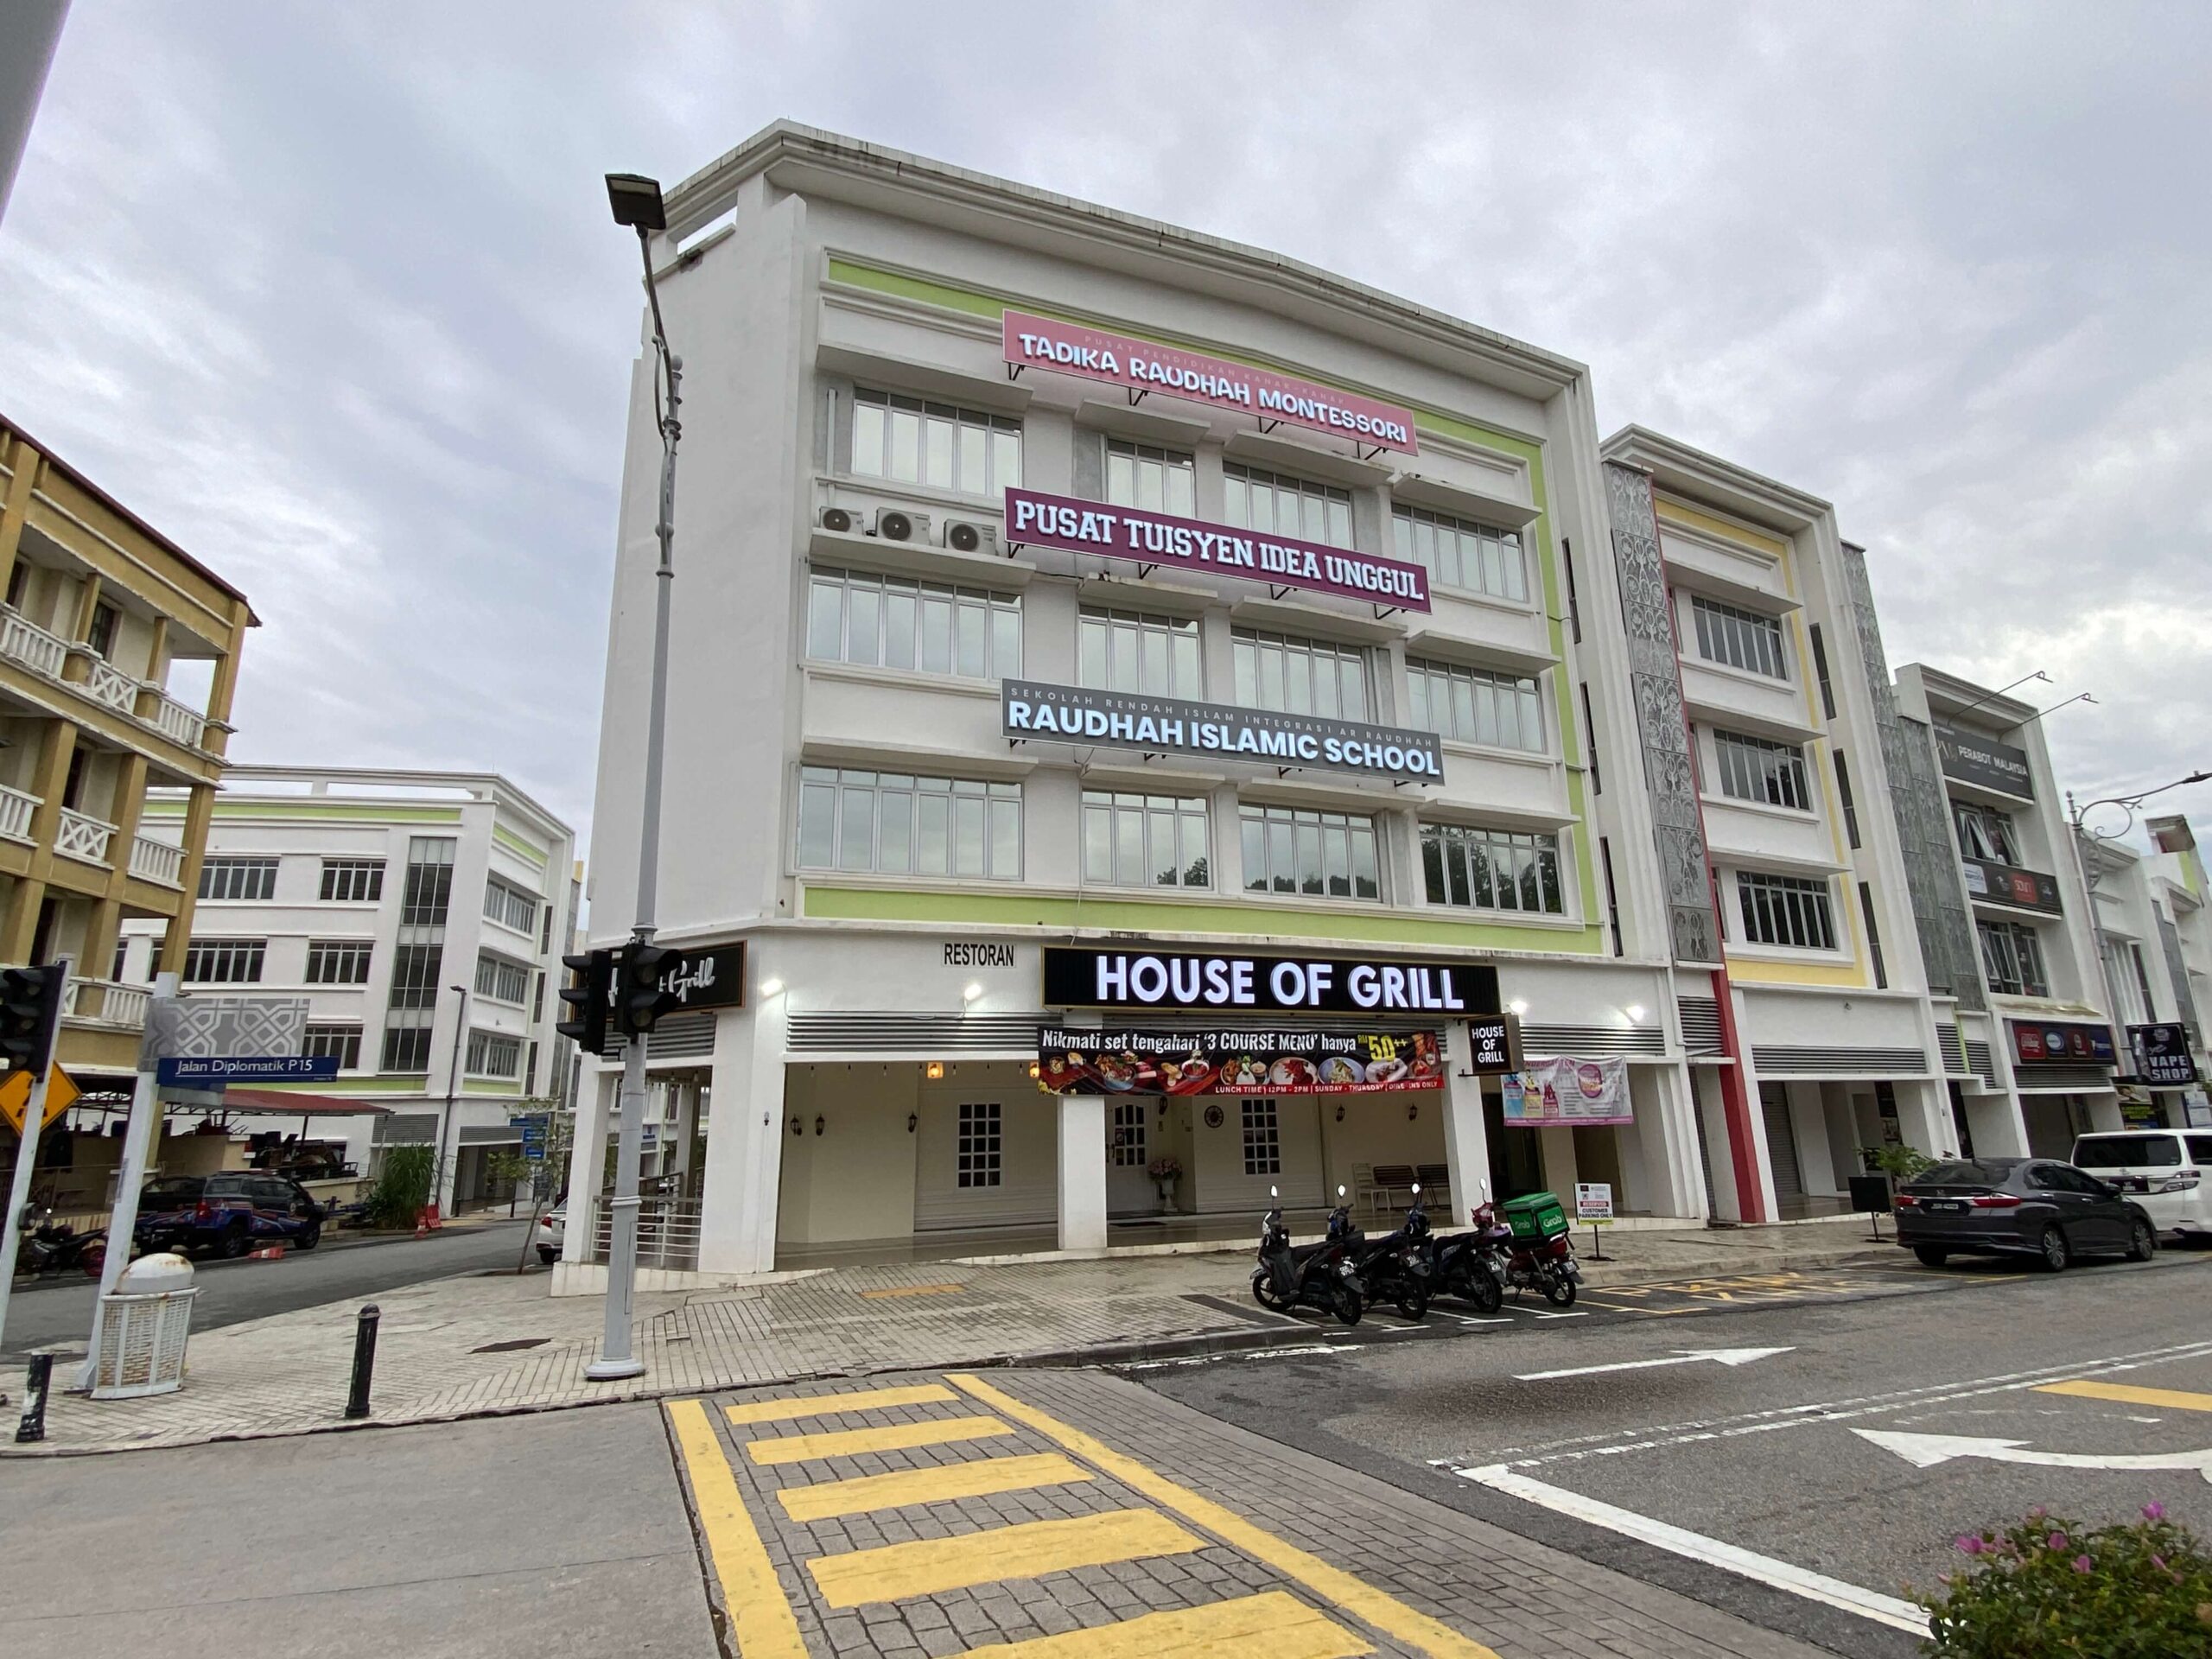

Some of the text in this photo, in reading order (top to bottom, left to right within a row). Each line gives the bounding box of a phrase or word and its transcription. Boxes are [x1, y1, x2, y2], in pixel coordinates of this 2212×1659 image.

[1084, 335, 1133, 353] PUSAT
[1143, 348, 1236, 378] PENDIDIKAN
[1018, 334, 1408, 443] TADIKA RAUDHAH MONTESSORI
[1014, 499, 1424, 600] PUSAT TUISYEN IDEA UNGGUL
[1010, 687, 1432, 747] SEKOLAH RENDAH ISLAM INTEGRASI AR RAUDHAH
[1007, 701, 1440, 776] RAUDHAH ISLAMIC SCHOOL
[1958, 745, 1991, 766] PERABOT
[944, 943, 1014, 967] RESTORAN
[1096, 955, 1465, 1009] HOUSE OF GRILL
[1042, 1029, 1101, 1050] Nikmati
[1104, 1033, 1128, 1050] set
[1132, 1033, 1200, 1053] tengahari
[1220, 1033, 1275, 1051] COURSE
[1321, 1033, 1357, 1053] hanya
[1471, 1025, 1504, 1039] HOUSE
[1482, 1039, 1496, 1051] OF
[176, 1060, 208, 1074] Jalan
[212, 1060, 284, 1074] Diplomatik
[1478, 1052, 1504, 1064] GRILL
[2149, 1055, 2188, 1067] VAPE
[2152, 1068, 2190, 1079] SHOP
[1215, 1085, 1242, 1094] LUNCH
[1244, 1085, 1262, 1094] TIME
[1314, 1084, 1343, 1093] SUNDAY
[1543, 1215, 1562, 1227] Grab
